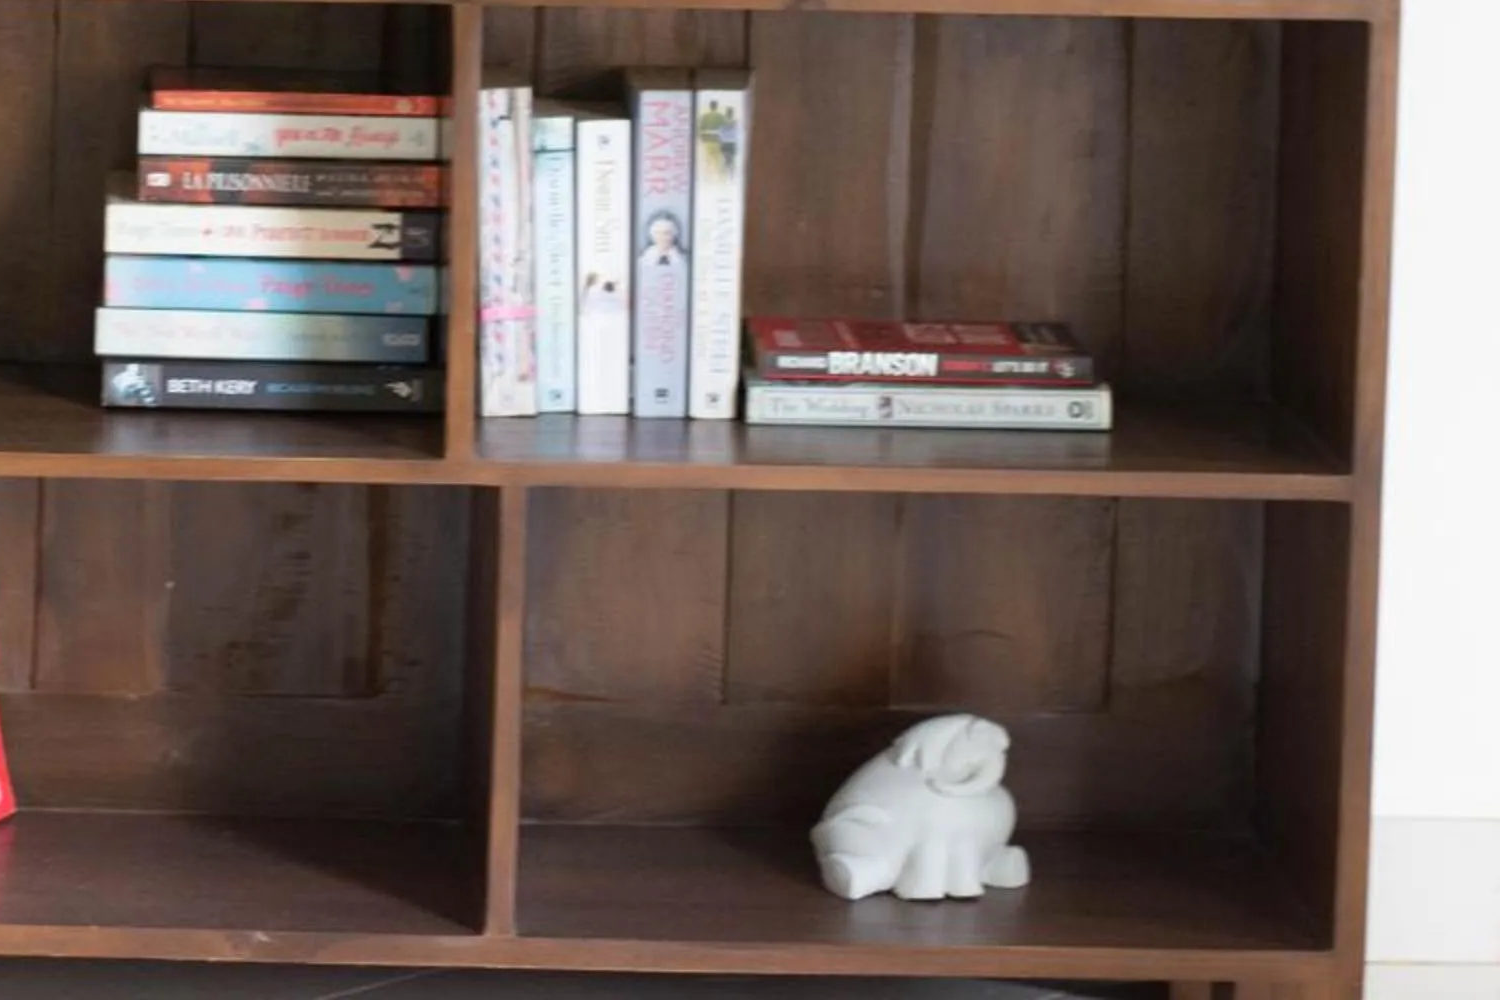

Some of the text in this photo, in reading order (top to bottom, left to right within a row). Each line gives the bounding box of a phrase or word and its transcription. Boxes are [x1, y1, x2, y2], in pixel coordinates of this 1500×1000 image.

[644, 99, 671, 197] MARR
[673, 99, 688, 195] ANDREW
[167, 379, 258, 394] BETH KERY
[828, 351, 938, 377] BRANSON
